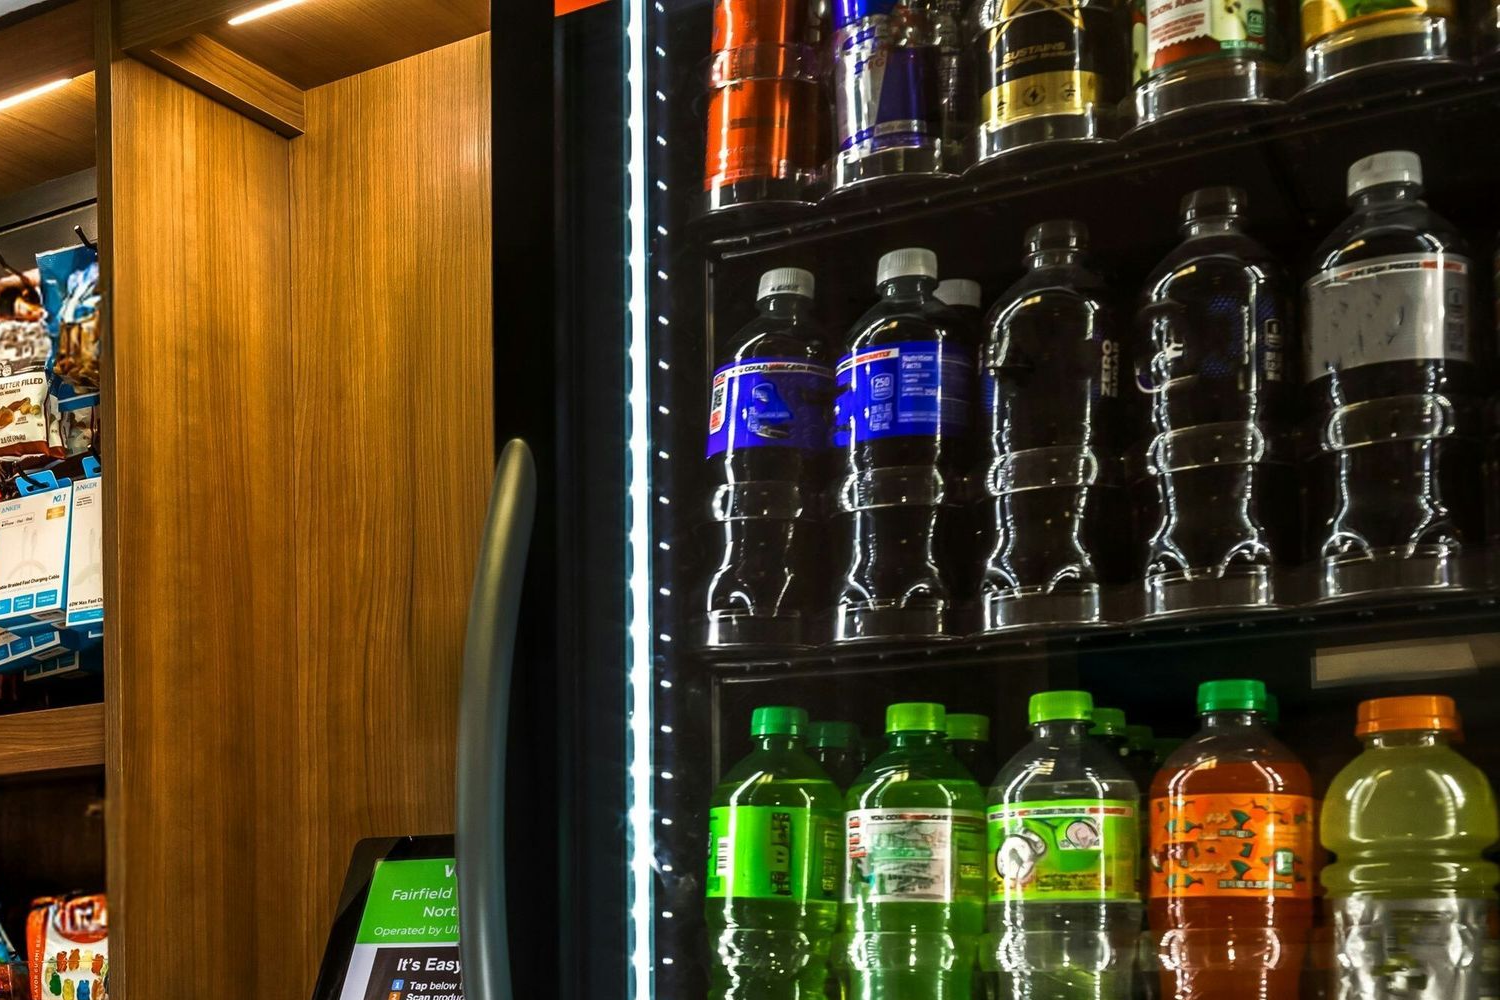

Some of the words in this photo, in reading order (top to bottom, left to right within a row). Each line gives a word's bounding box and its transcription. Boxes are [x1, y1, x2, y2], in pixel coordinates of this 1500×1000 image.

[901, 362, 922, 370] Facts
[1101, 340, 1113, 397] ZERO
[21, 377, 44, 387] FILLED
[875, 377, 890, 388] 250
[75, 481, 98, 492] ANKER
[0, 504, 22, 513] ANKER
[7, 581, 22, 589] Braided
[31, 576, 48, 586] Charging
[391, 888, 452, 901] Fairfield
[423, 906, 458, 918] Nort
[374, 927, 425, 937] Operated
[428, 926, 441, 936] by
[397, 958, 422, 972] It's
[425, 958, 462, 973] Easy
[409, 981, 428, 991] Tap
[429, 981, 456, 990] below
